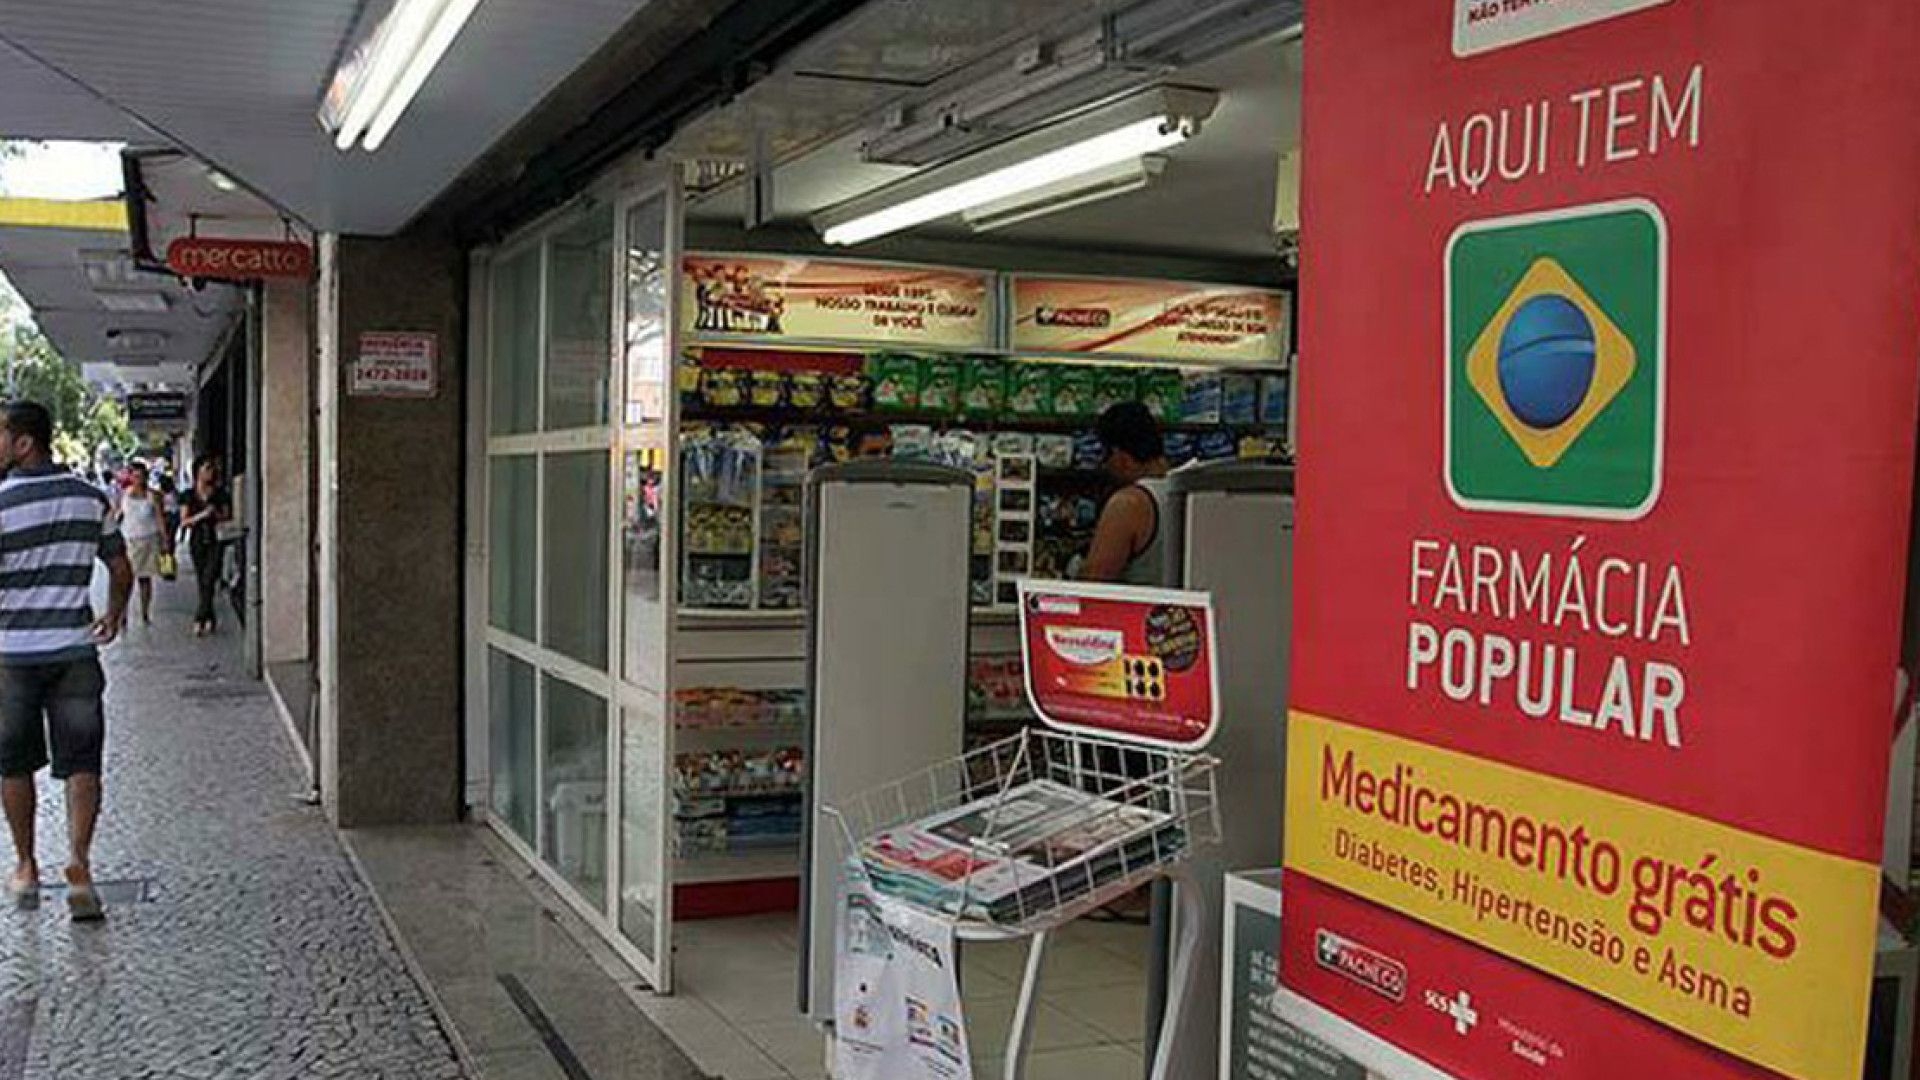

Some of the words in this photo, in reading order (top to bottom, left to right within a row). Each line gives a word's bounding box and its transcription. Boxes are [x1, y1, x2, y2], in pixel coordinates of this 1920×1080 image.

[1424, 101, 1549, 194] AQUI
[1571, 65, 1702, 166] TEM
[182, 247, 300, 271] mercatto
[815, 296, 862, 311] NOSSO
[1409, 537, 1690, 646] FARMÁCIA
[1406, 622, 1682, 747] POPULAR
[1321, 743, 1618, 895] Medicamento
[1630, 853, 1798, 959] grátis
[1334, 829, 1445, 901] Diabetes,
[1452, 872, 1624, 964] Hipertensão
[1634, 948, 1651, 975] e
[1658, 948, 1752, 1018] Asma
[1338, 949, 1402, 994] PACHECO
